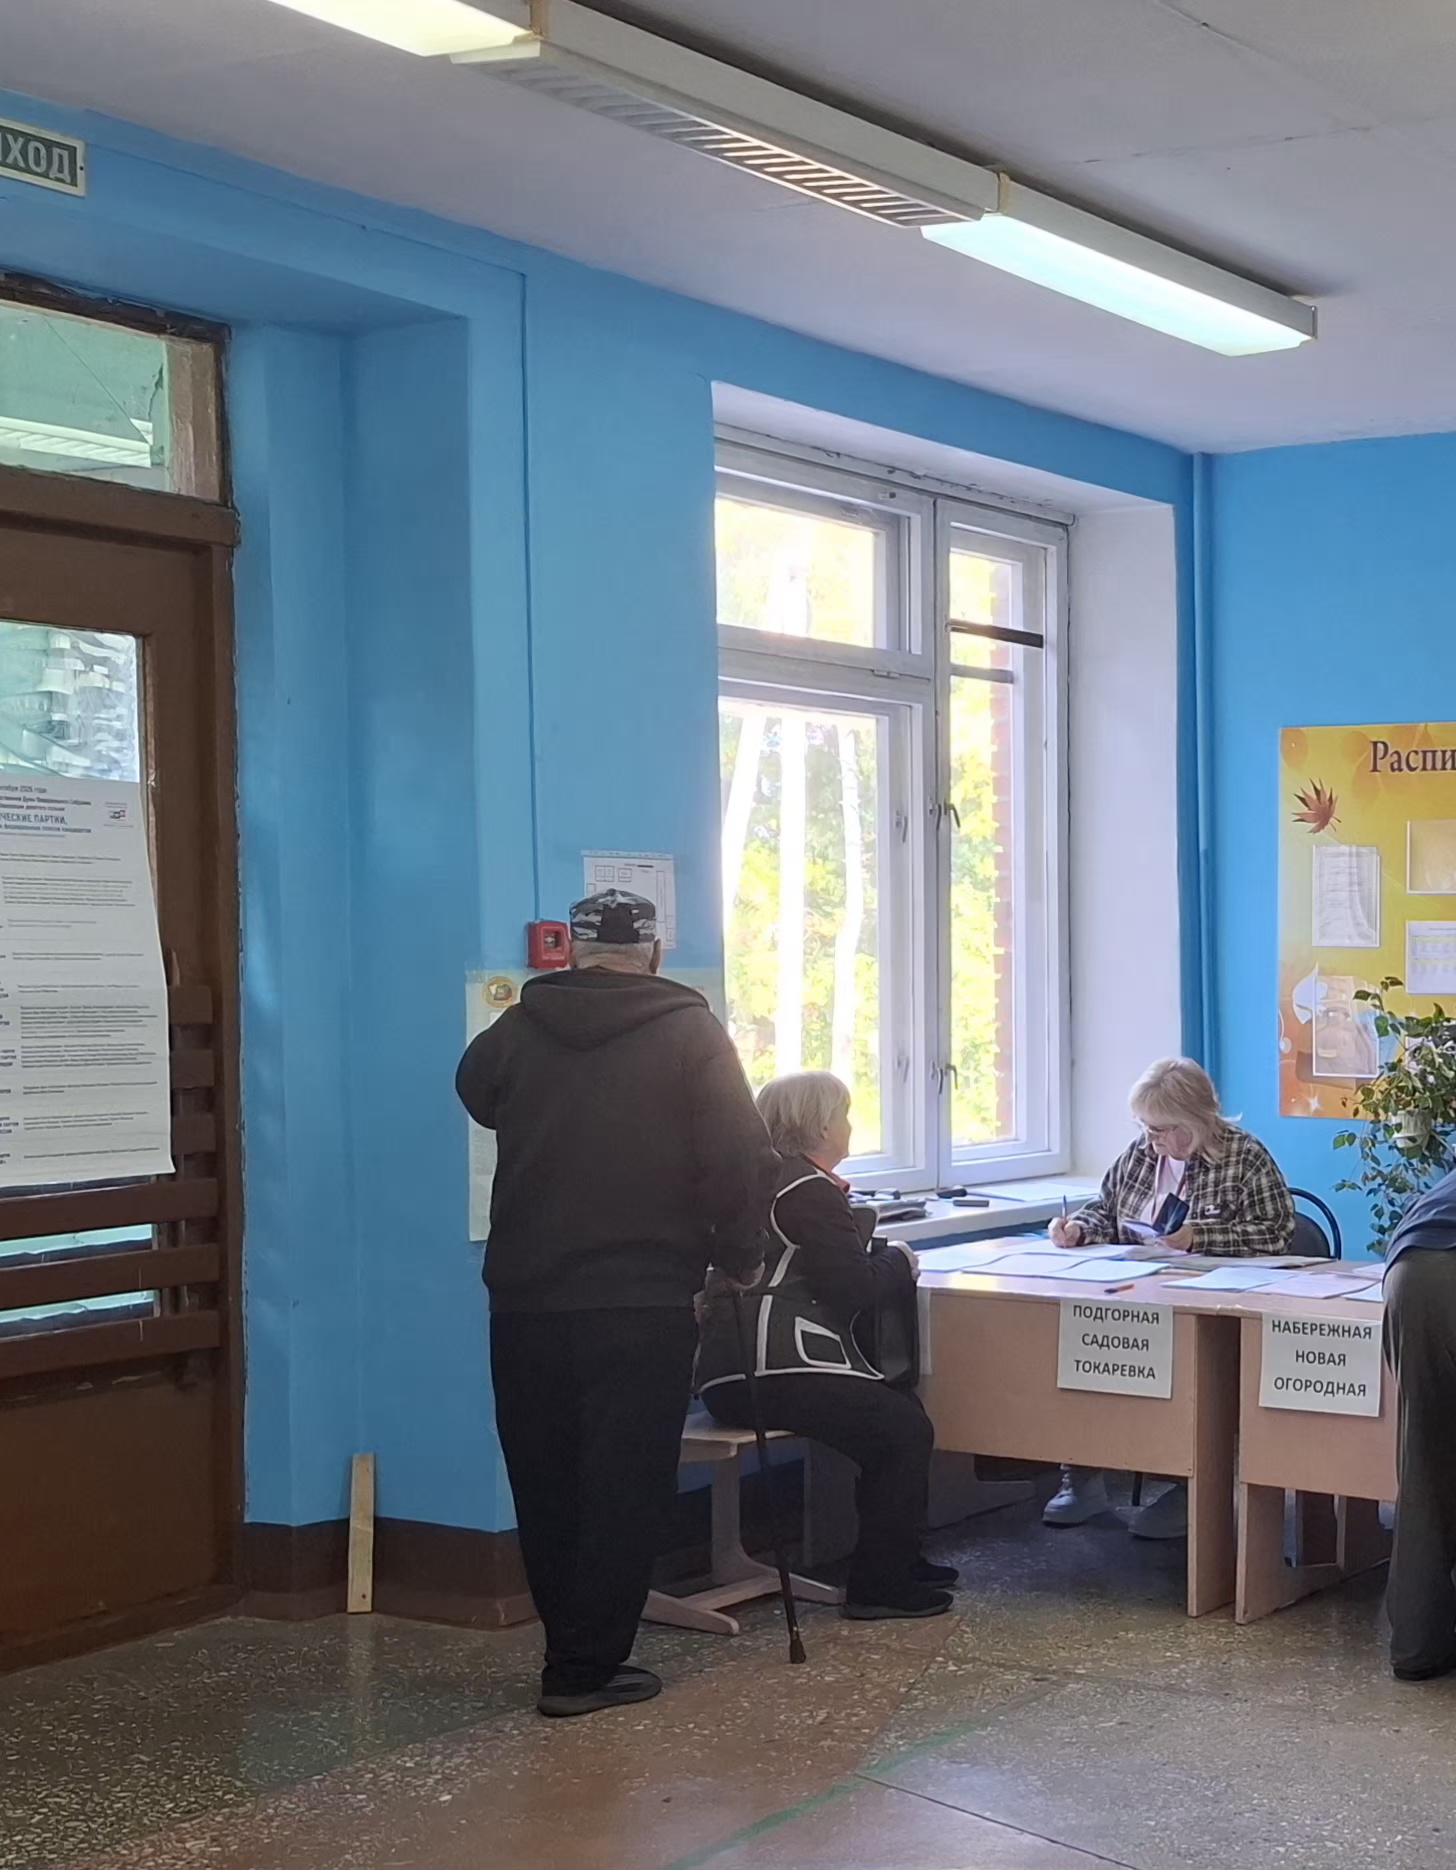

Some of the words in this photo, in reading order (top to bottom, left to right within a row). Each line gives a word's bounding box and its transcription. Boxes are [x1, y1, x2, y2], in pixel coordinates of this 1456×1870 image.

[0, 132, 71, 183] ХОД
[0, 812, 31, 824] ЧЕСКИЕ
[1073, 1304, 1160, 1325] ПОДГОРНАЯ
[1271, 1319, 1372, 1340] НАБЕРЕЖНАЯ
[1081, 1333, 1150, 1351] САДОВАЯ
[1295, 1349, 1347, 1367] НОВАЯ
[1074, 1359, 1156, 1380] ТОКАРЕВКА
[1273, 1376, 1367, 1398] ОГОРОДНАЯ
